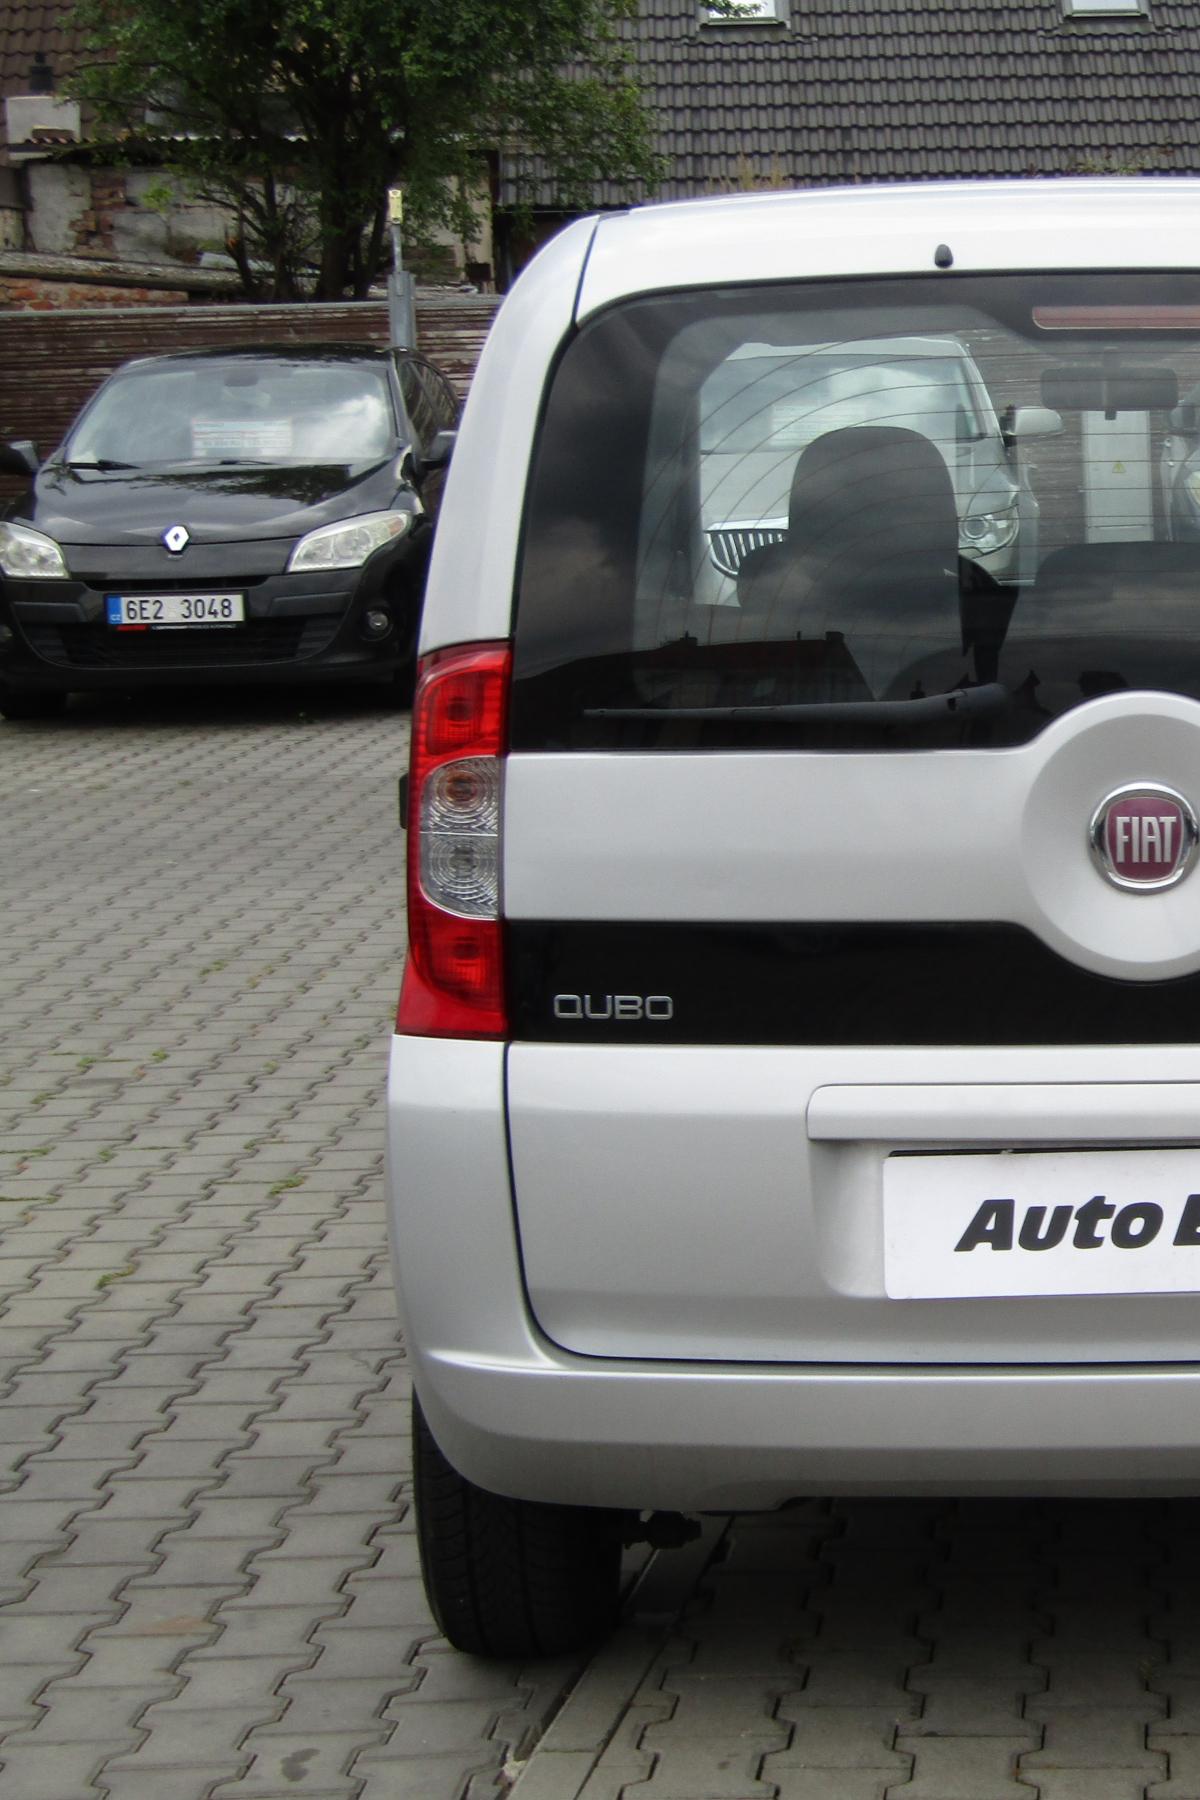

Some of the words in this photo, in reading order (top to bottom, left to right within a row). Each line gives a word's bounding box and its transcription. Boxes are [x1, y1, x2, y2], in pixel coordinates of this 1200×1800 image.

[126, 600, 164, 620] 6E2
[181, 599, 232, 618] 3048
[1116, 816, 1177, 863] FIAT
[554, 994, 673, 1020] QUBO
[953, 1195, 1164, 1252] Auto
